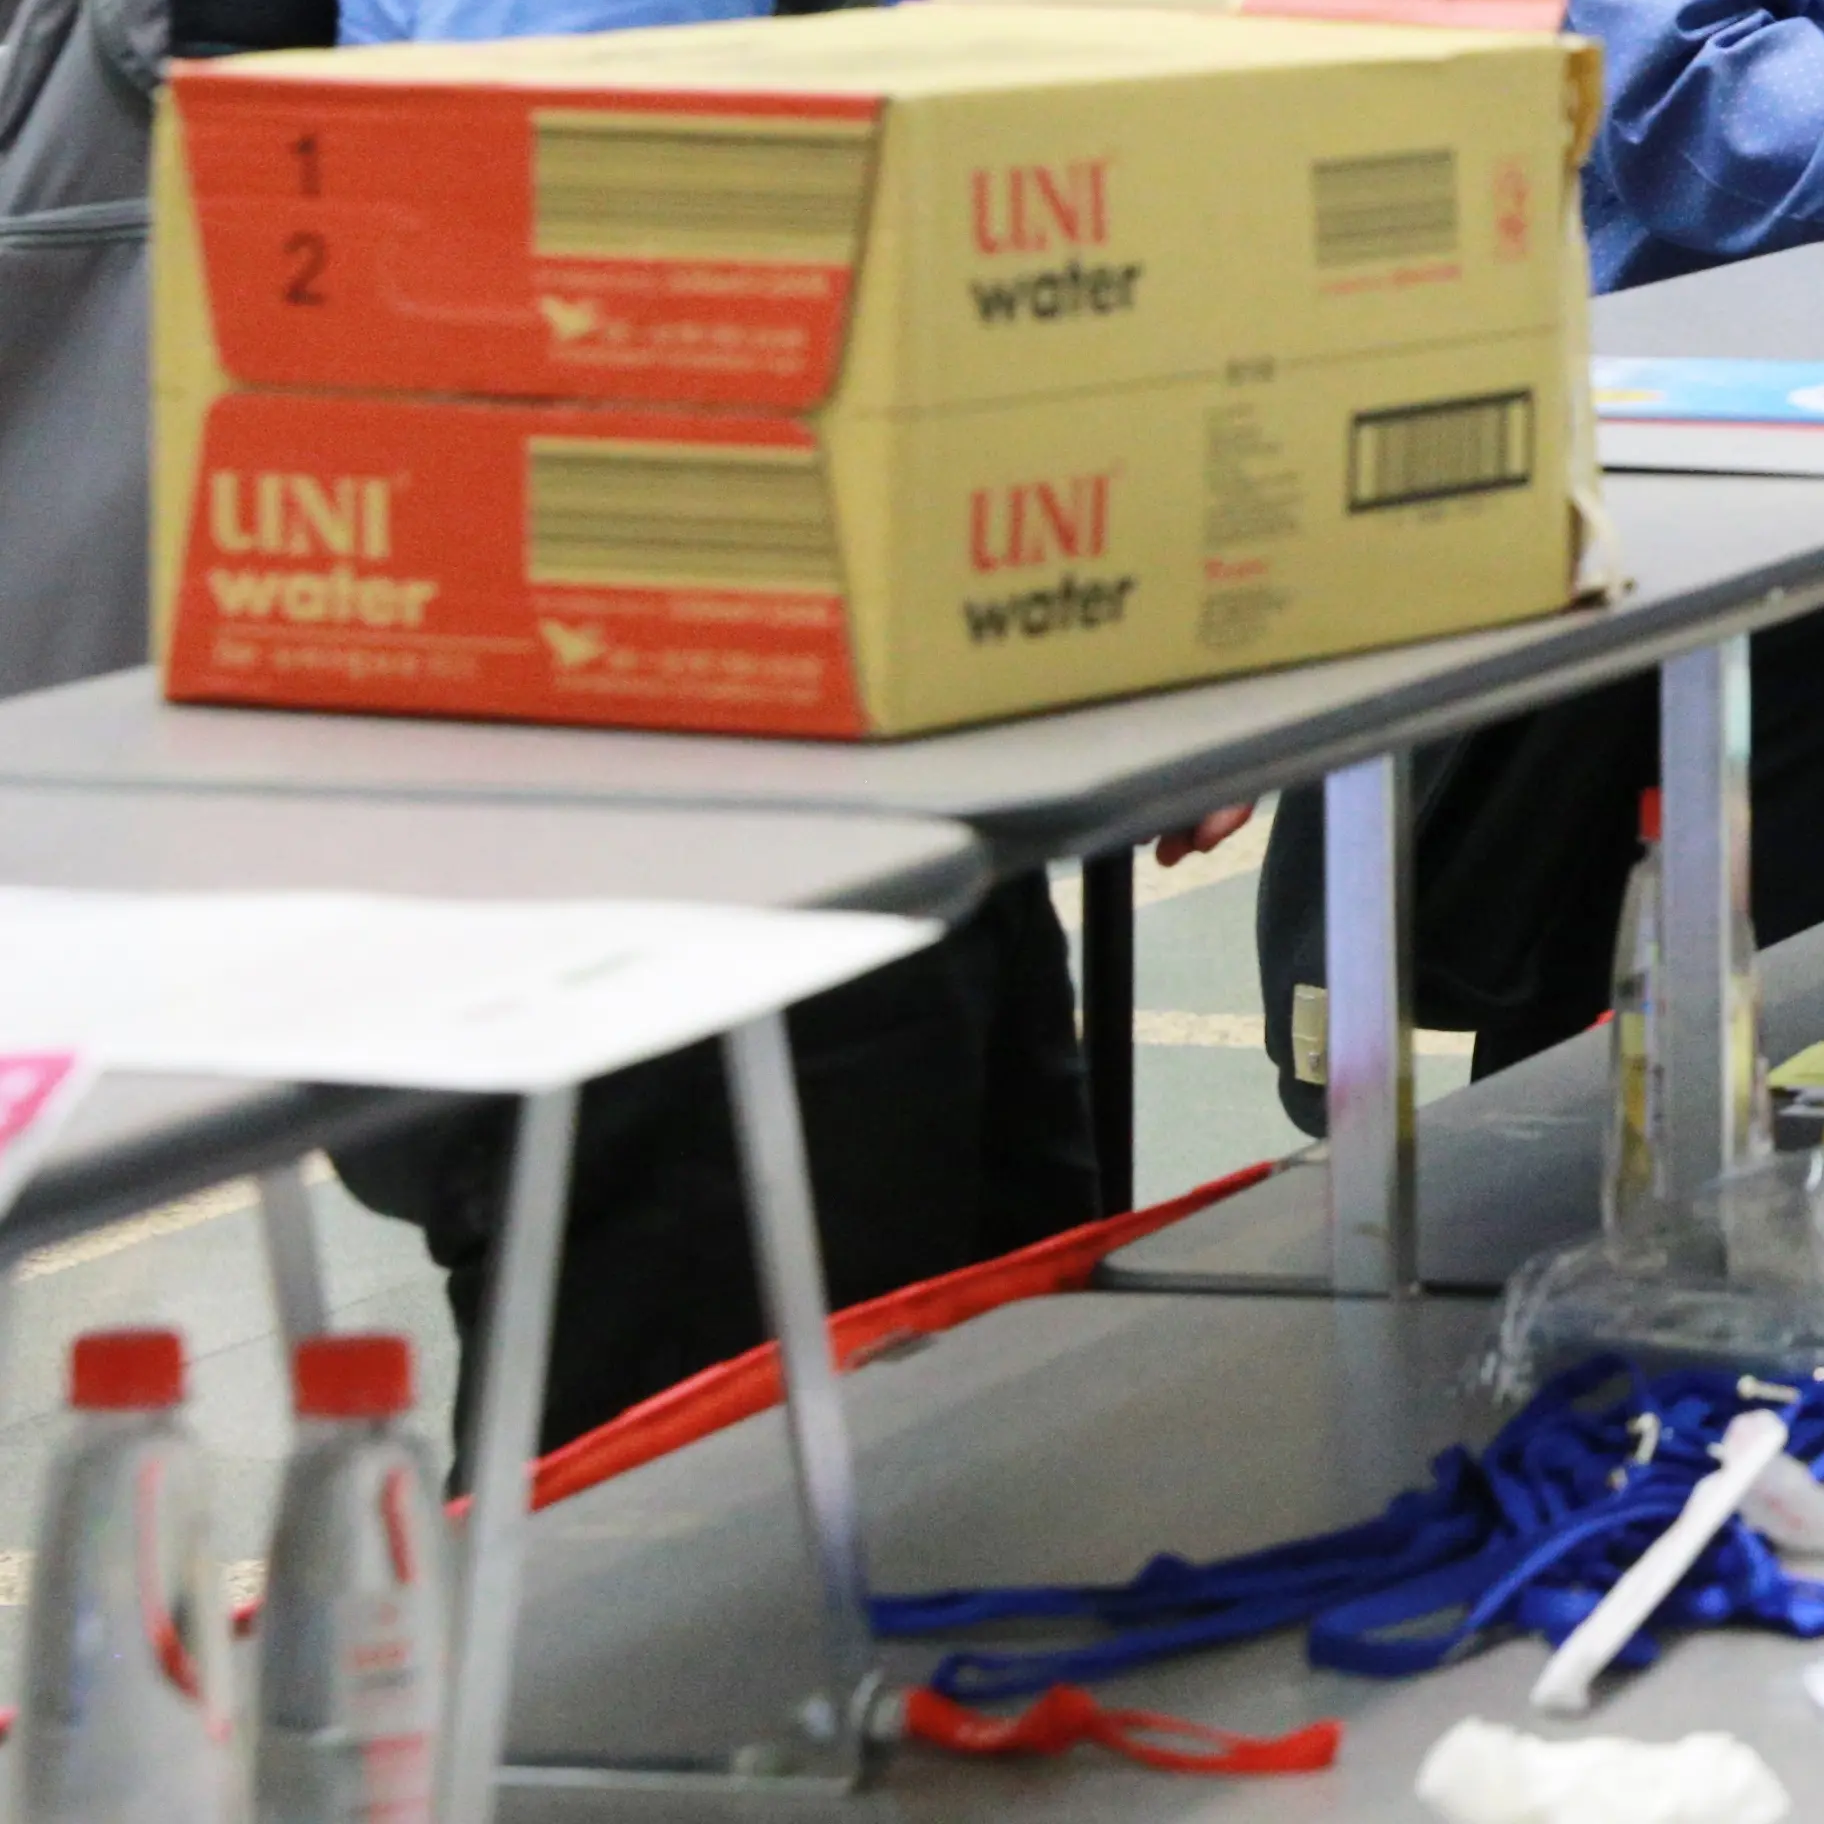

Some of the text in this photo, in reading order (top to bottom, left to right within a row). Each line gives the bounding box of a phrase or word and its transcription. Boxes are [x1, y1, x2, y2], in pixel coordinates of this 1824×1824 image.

[286, 131, 323, 199] 1
[970, 156, 1112, 257] UNI
[281, 229, 328, 307] 2
[969, 260, 1142, 323] water
[209, 472, 393, 560] UNI
[969, 476, 1112, 575] UNI
[207, 567, 440, 627] water
[962, 575, 1136, 644] water
